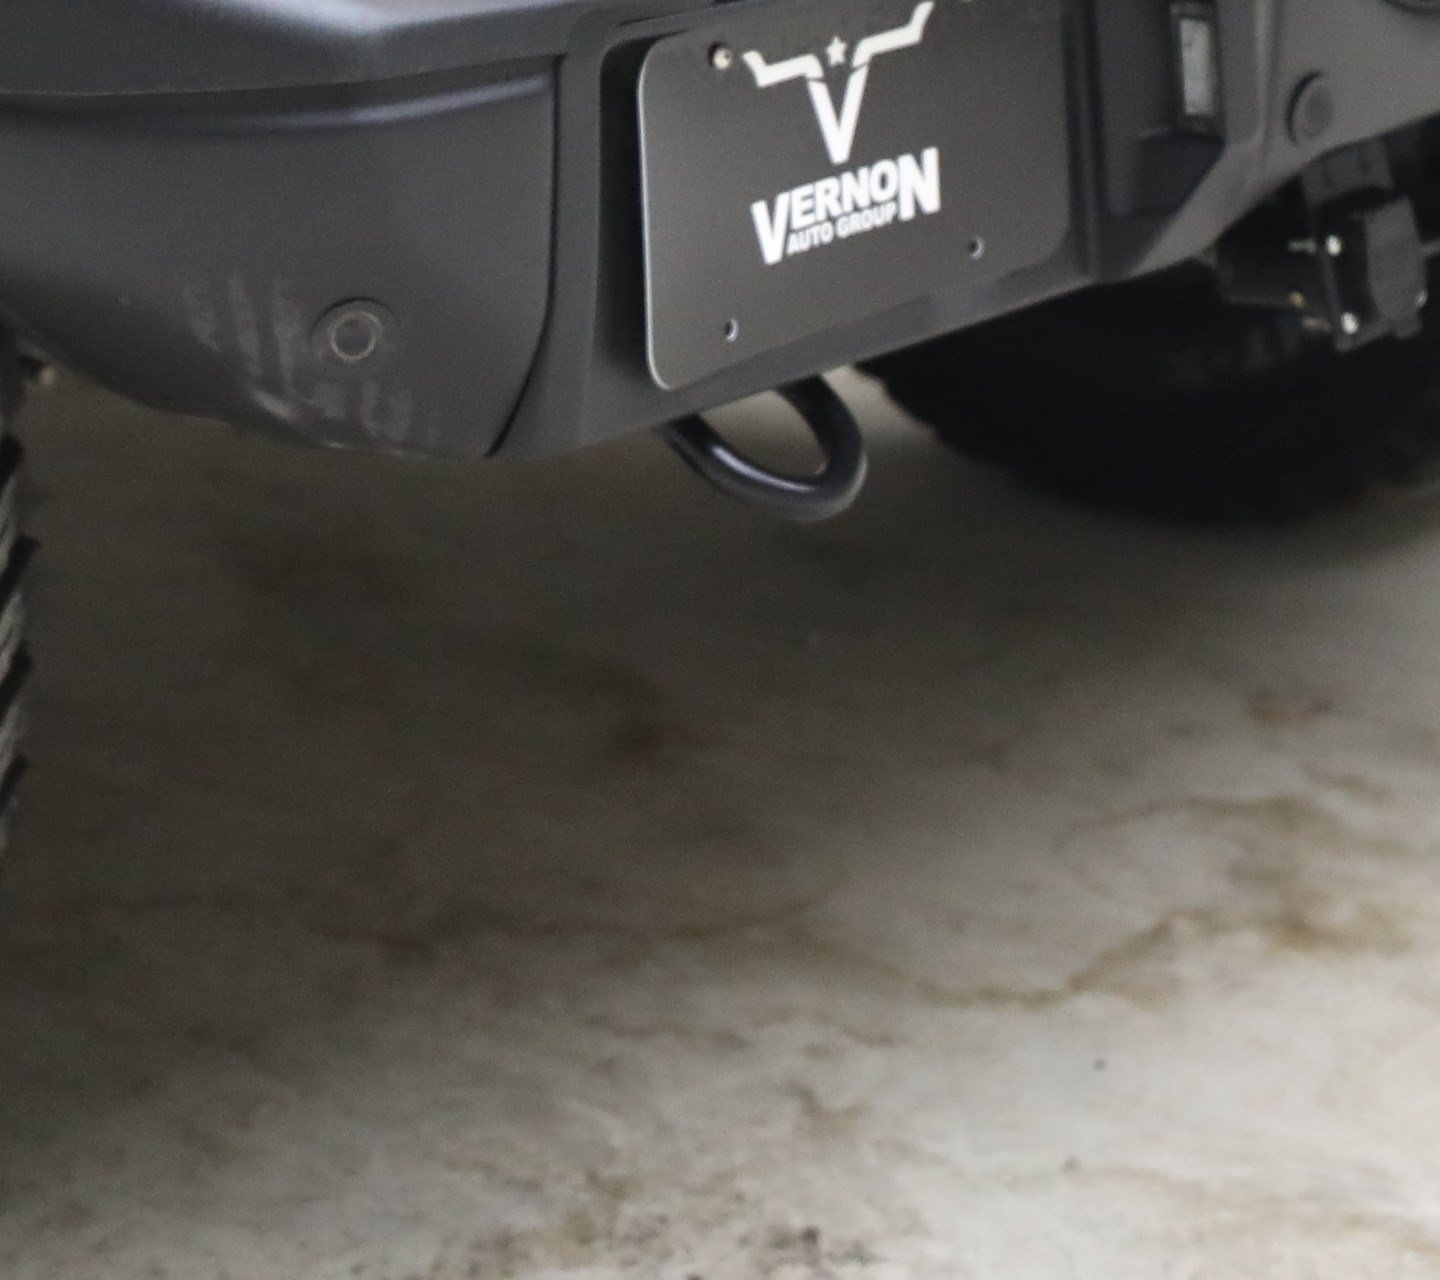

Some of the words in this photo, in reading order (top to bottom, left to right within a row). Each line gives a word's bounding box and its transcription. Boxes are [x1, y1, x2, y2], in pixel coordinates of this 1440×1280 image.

[751, 146, 942, 265] VERNON
[787, 221, 835, 256] AUTO
[835, 201, 898, 239] GROUP
